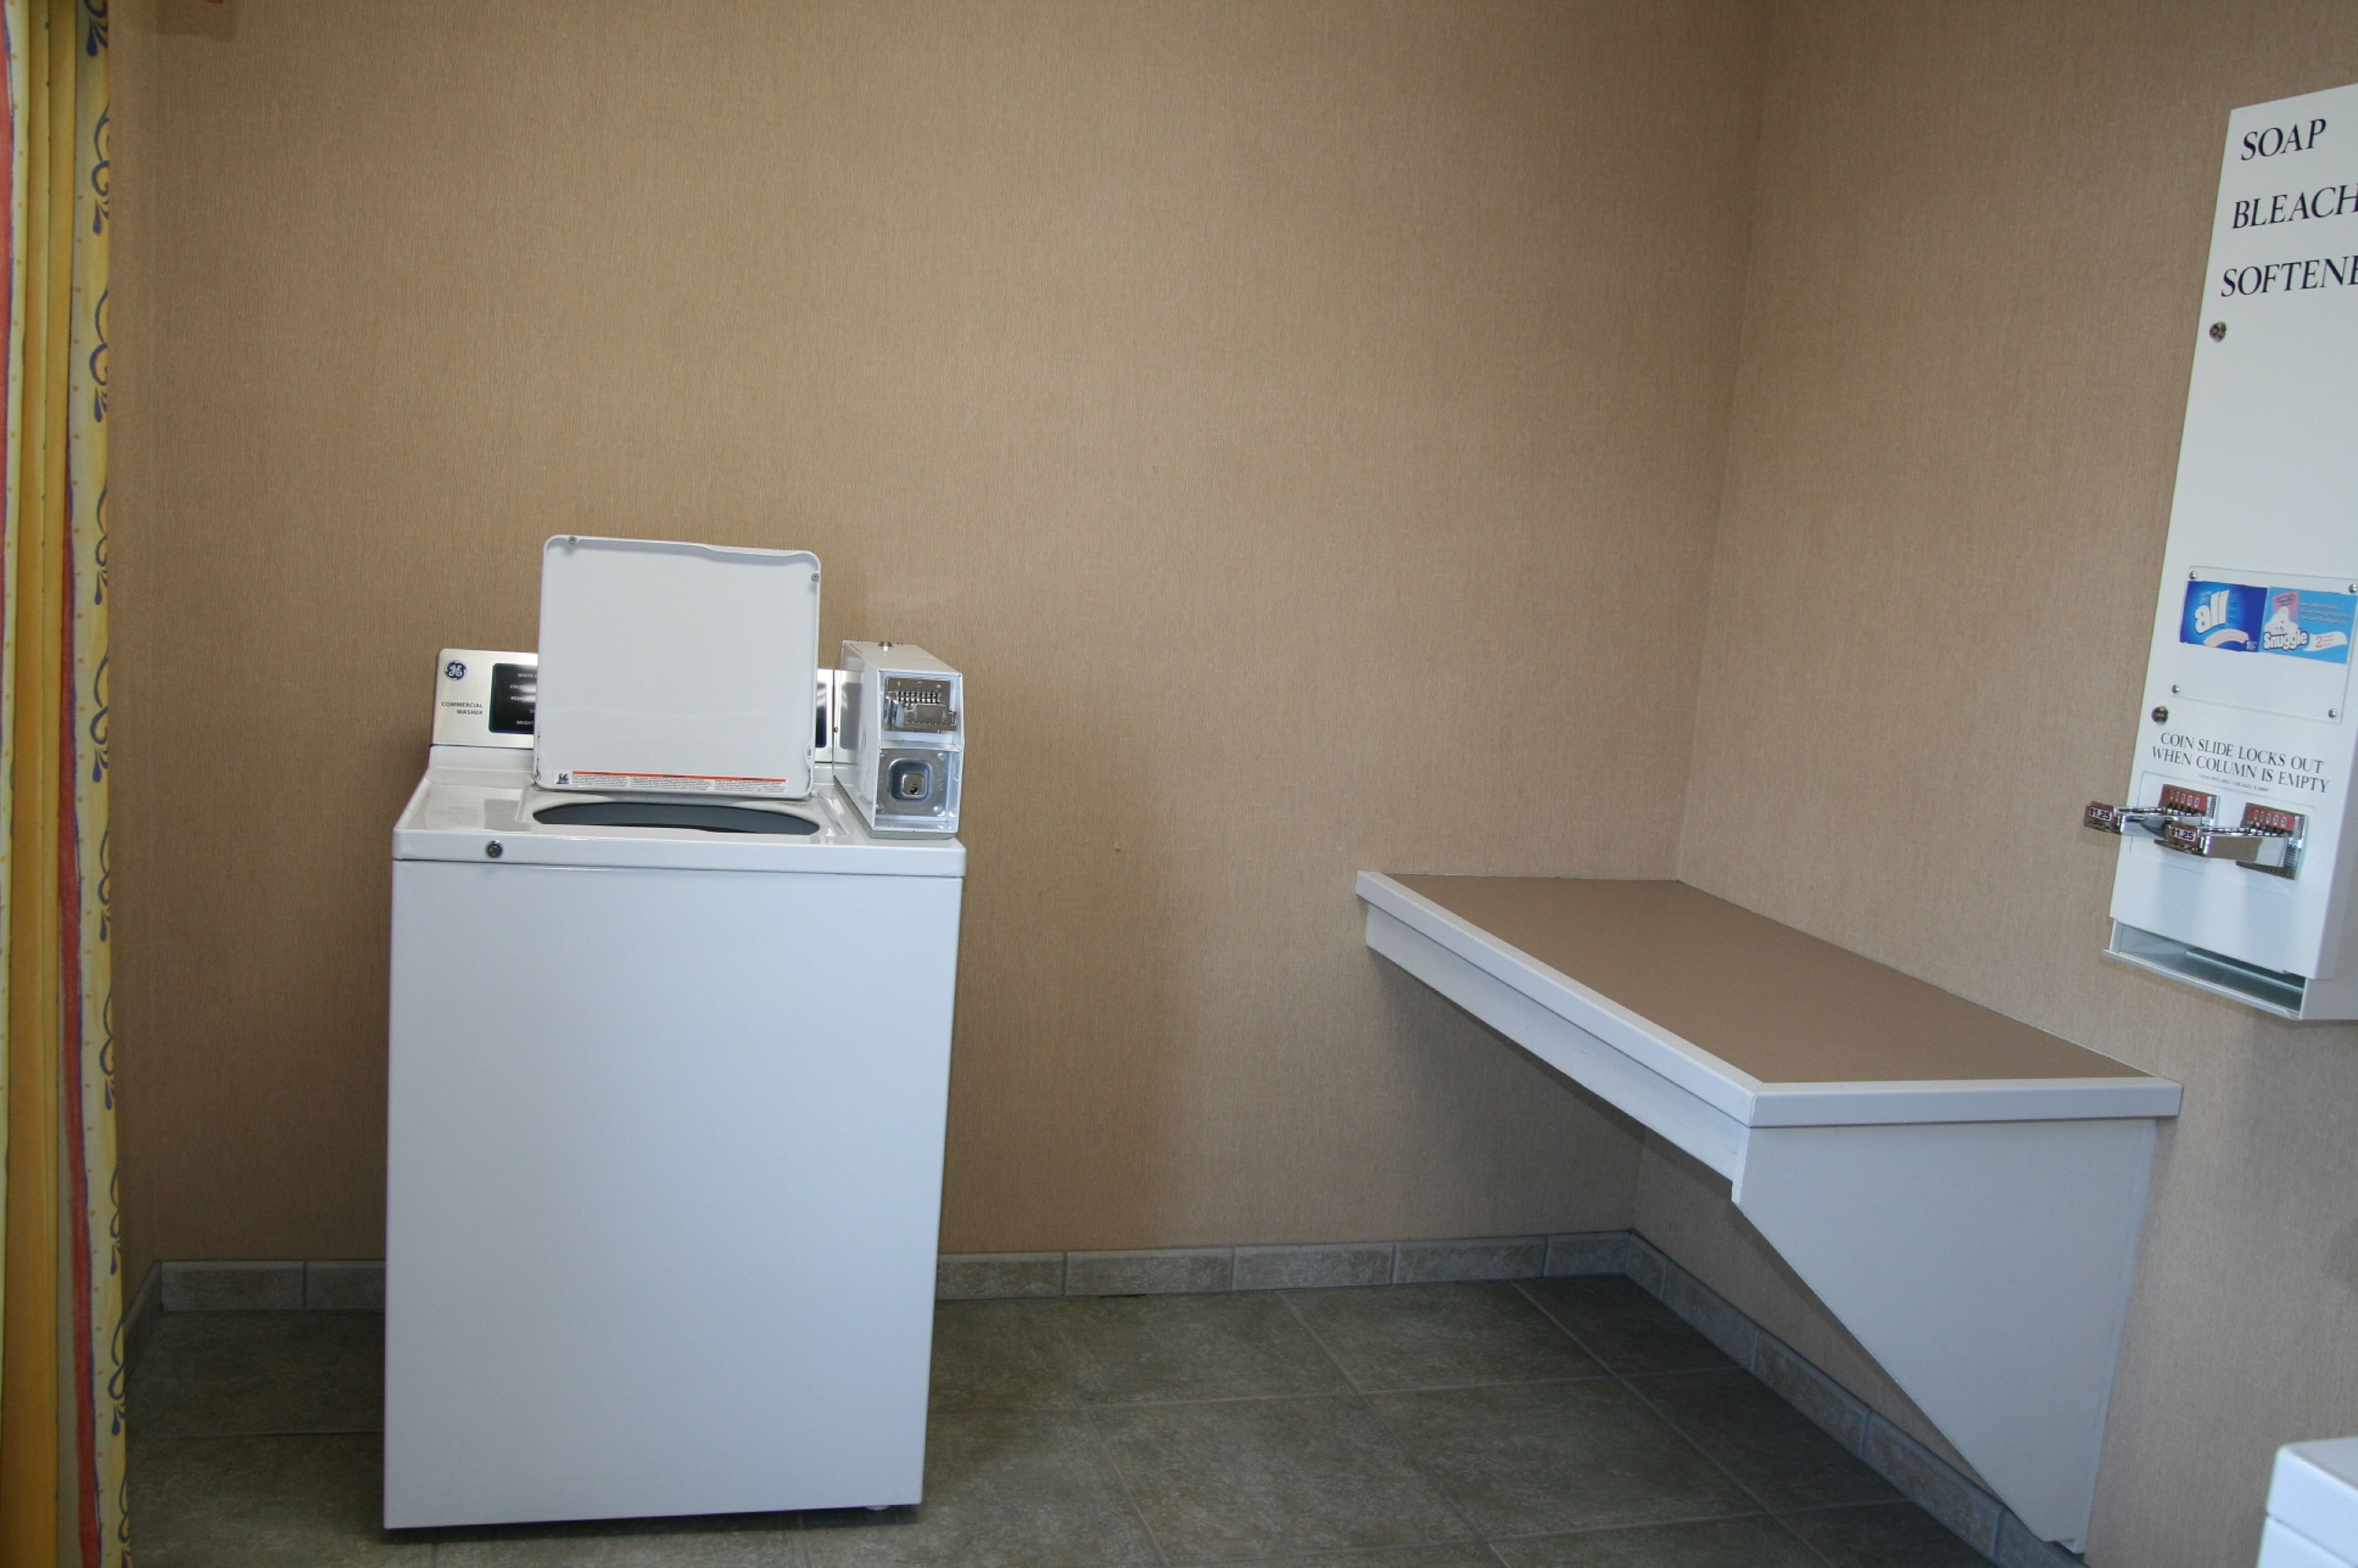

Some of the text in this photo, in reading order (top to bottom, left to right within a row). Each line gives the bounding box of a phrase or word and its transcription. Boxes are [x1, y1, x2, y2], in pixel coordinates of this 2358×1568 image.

[2241, 118, 2326, 161] SOAP
[2232, 183, 2358, 229] BLEACH
[2262, 627, 2308, 651] Snuggle
[2152, 745, 2192, 766] WHEN
[2197, 755, 2257, 778] COLUMN
[2261, 767, 2274, 782] IS
[2278, 771, 2330, 793] EMPTY
[2160, 732, 2324, 774] COIN SLIDE LOCKS OUT
[2089, 807, 2111, 820] $1.25
[2171, 826, 2194, 841] $1.25
